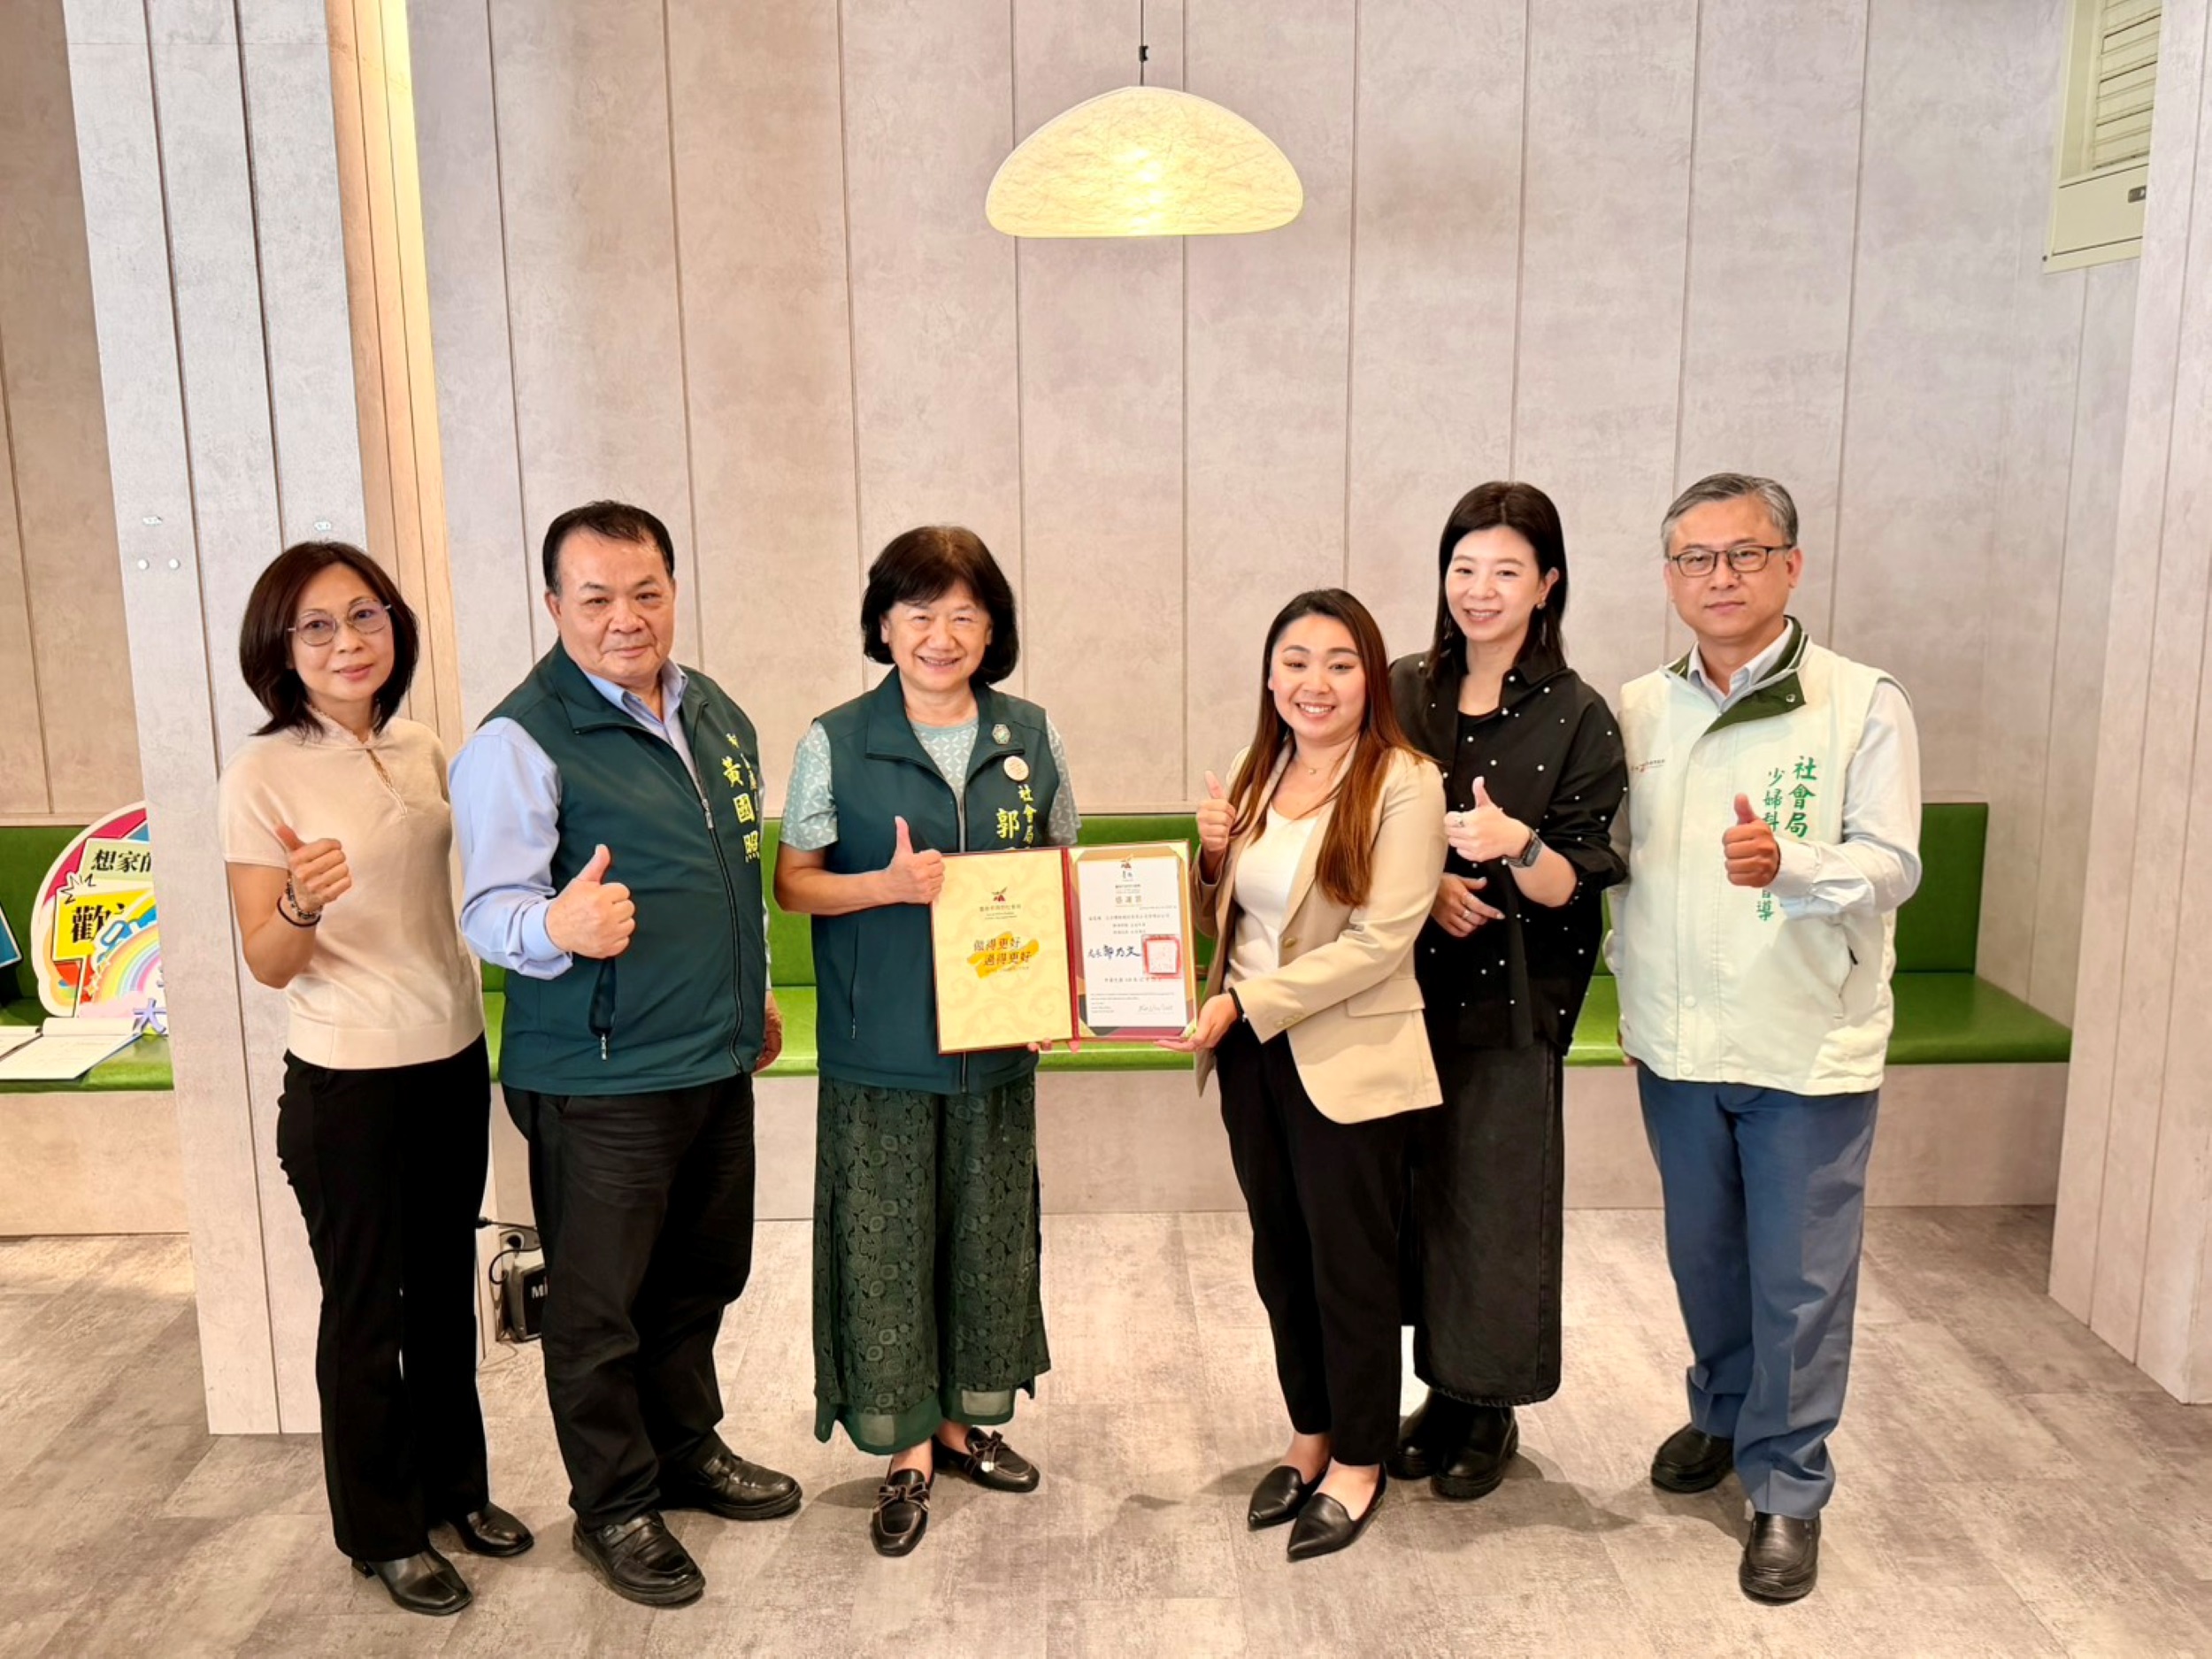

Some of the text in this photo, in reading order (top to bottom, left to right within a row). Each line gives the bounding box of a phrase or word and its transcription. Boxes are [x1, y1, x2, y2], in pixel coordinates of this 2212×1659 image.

[995, 807, 1020, 849] 郭
[1018, 783, 1038, 849] 社會局
[1785, 755, 1817, 838] 社會局
